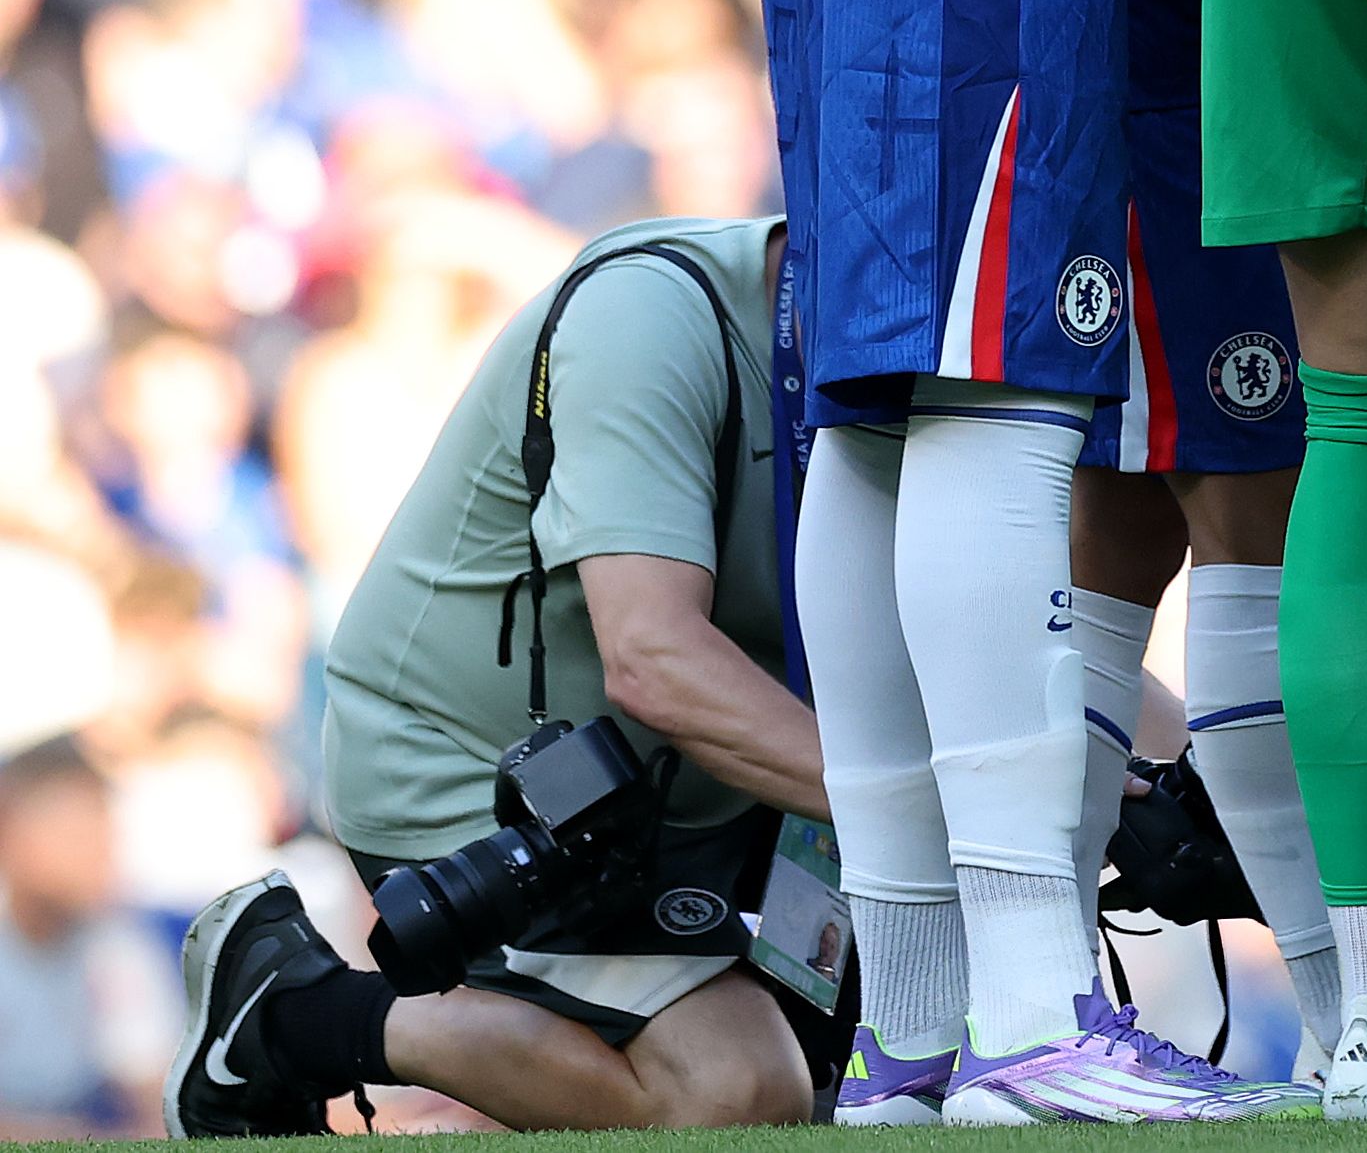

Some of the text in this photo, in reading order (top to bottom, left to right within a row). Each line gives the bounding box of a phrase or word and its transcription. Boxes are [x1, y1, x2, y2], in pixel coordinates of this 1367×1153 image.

[1068, 259, 1110, 280] CHELSEA
[1219, 334, 1275, 359] CHELSEA
[534, 350, 548, 419] Nikon
